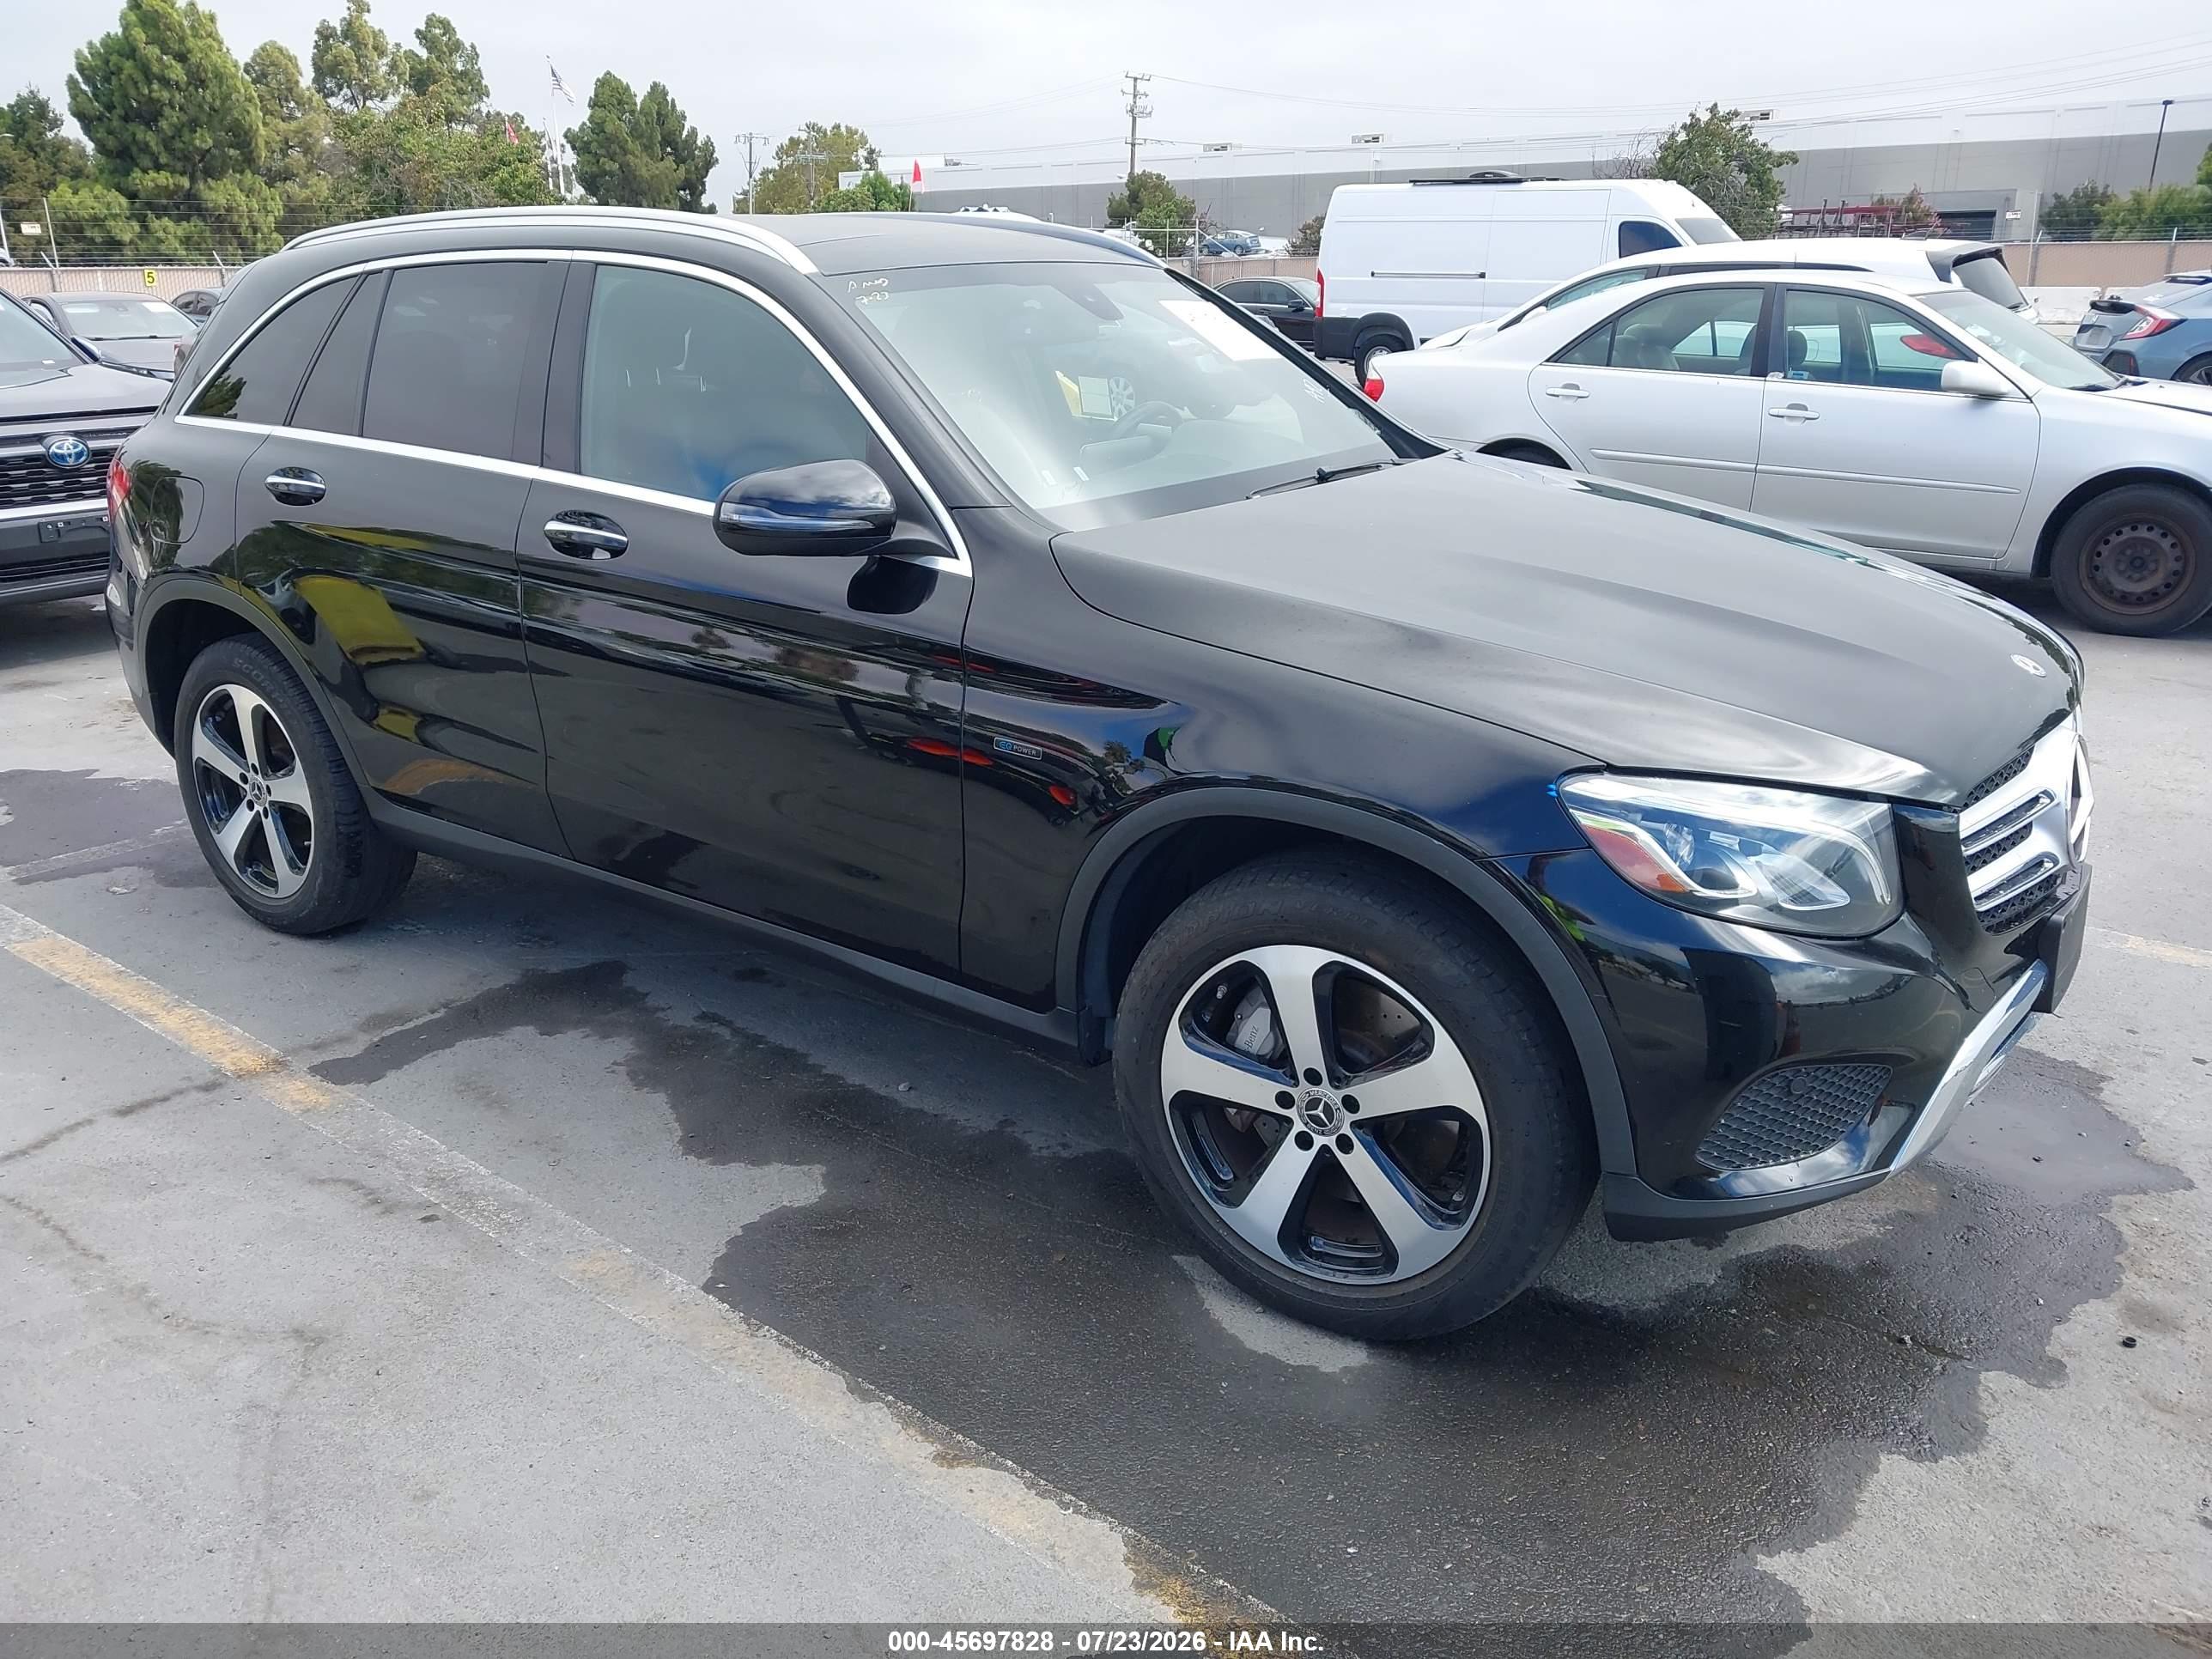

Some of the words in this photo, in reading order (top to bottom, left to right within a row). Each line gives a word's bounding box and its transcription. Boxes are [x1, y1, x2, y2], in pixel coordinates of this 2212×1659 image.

[147, 271, 155, 284] 5
[999, 741, 1012, 750] EQ
[1013, 744, 1036, 756] POWER
[1310, 1090, 1340, 1109] MERCEDES
